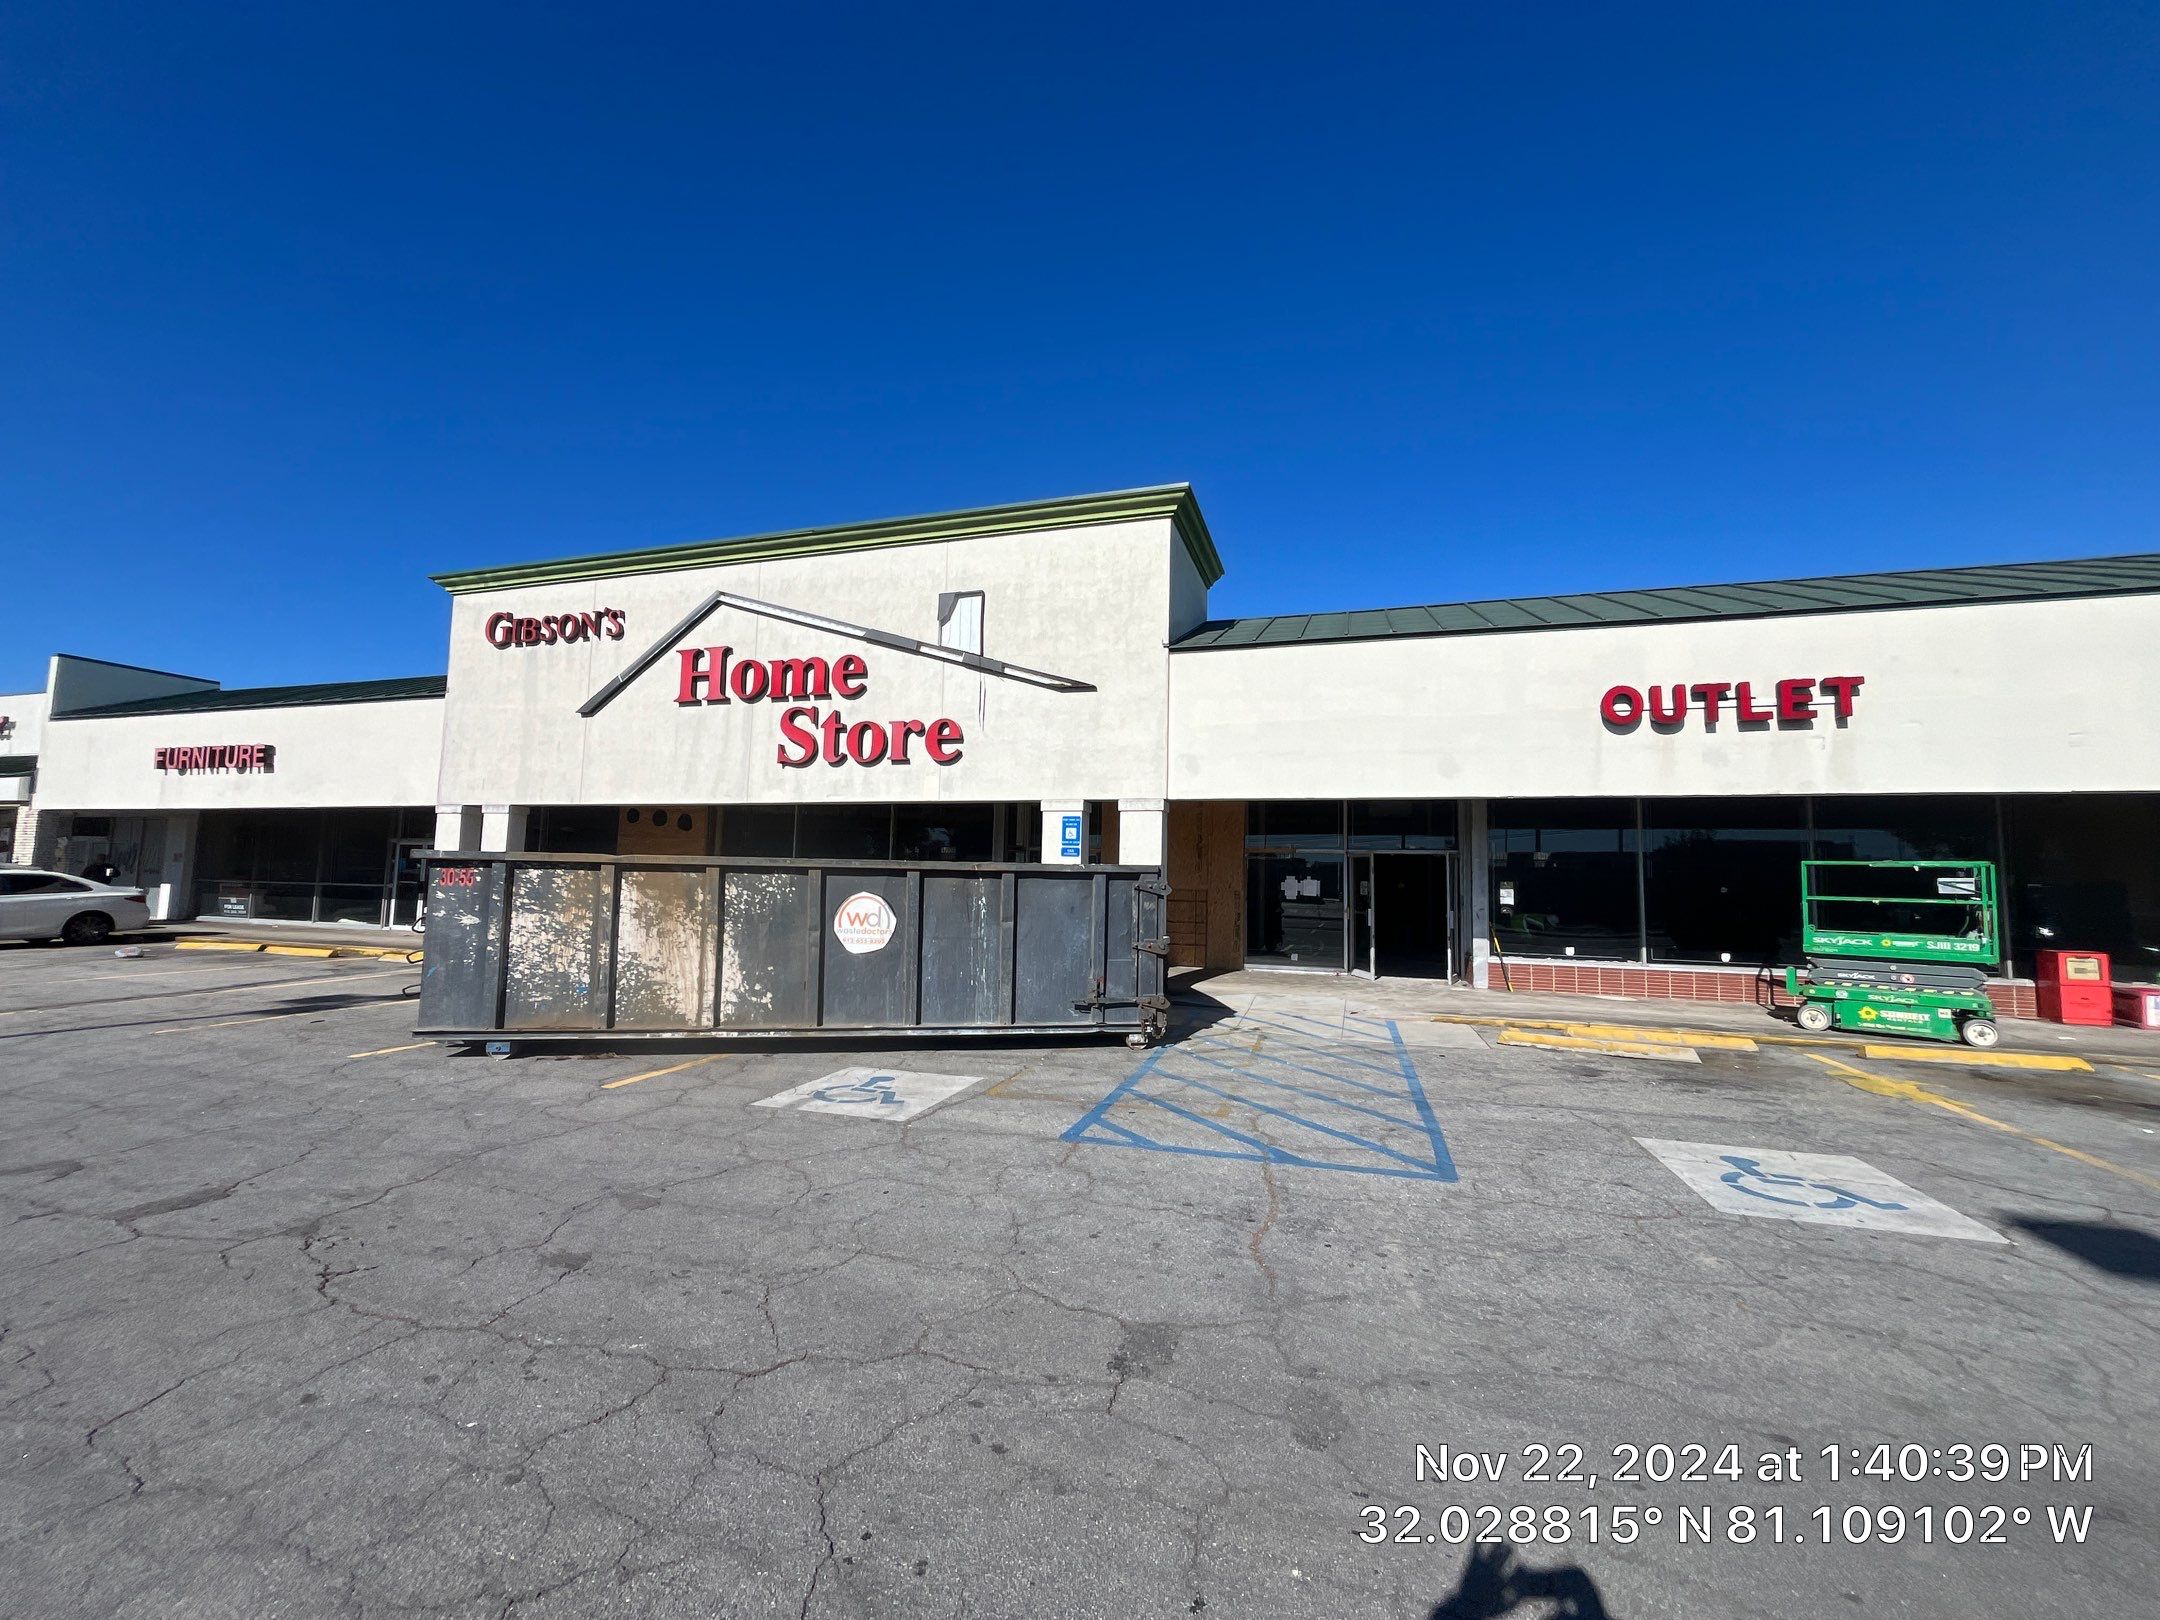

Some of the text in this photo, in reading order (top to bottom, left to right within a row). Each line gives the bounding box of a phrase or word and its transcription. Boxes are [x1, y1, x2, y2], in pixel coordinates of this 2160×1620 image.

[485, 607, 625, 650] GIBSON'S
[674, 646, 868, 707] Home
[1600, 676, 1865, 727] OUTLET
[776, 706, 964, 768] Store
[154, 743, 267, 769] FURNITURE
[440, 867, 474, 886] 30-55
[1812, 935, 1873, 946] SKYJACK
[1953, 942, 1980, 952] 3219
